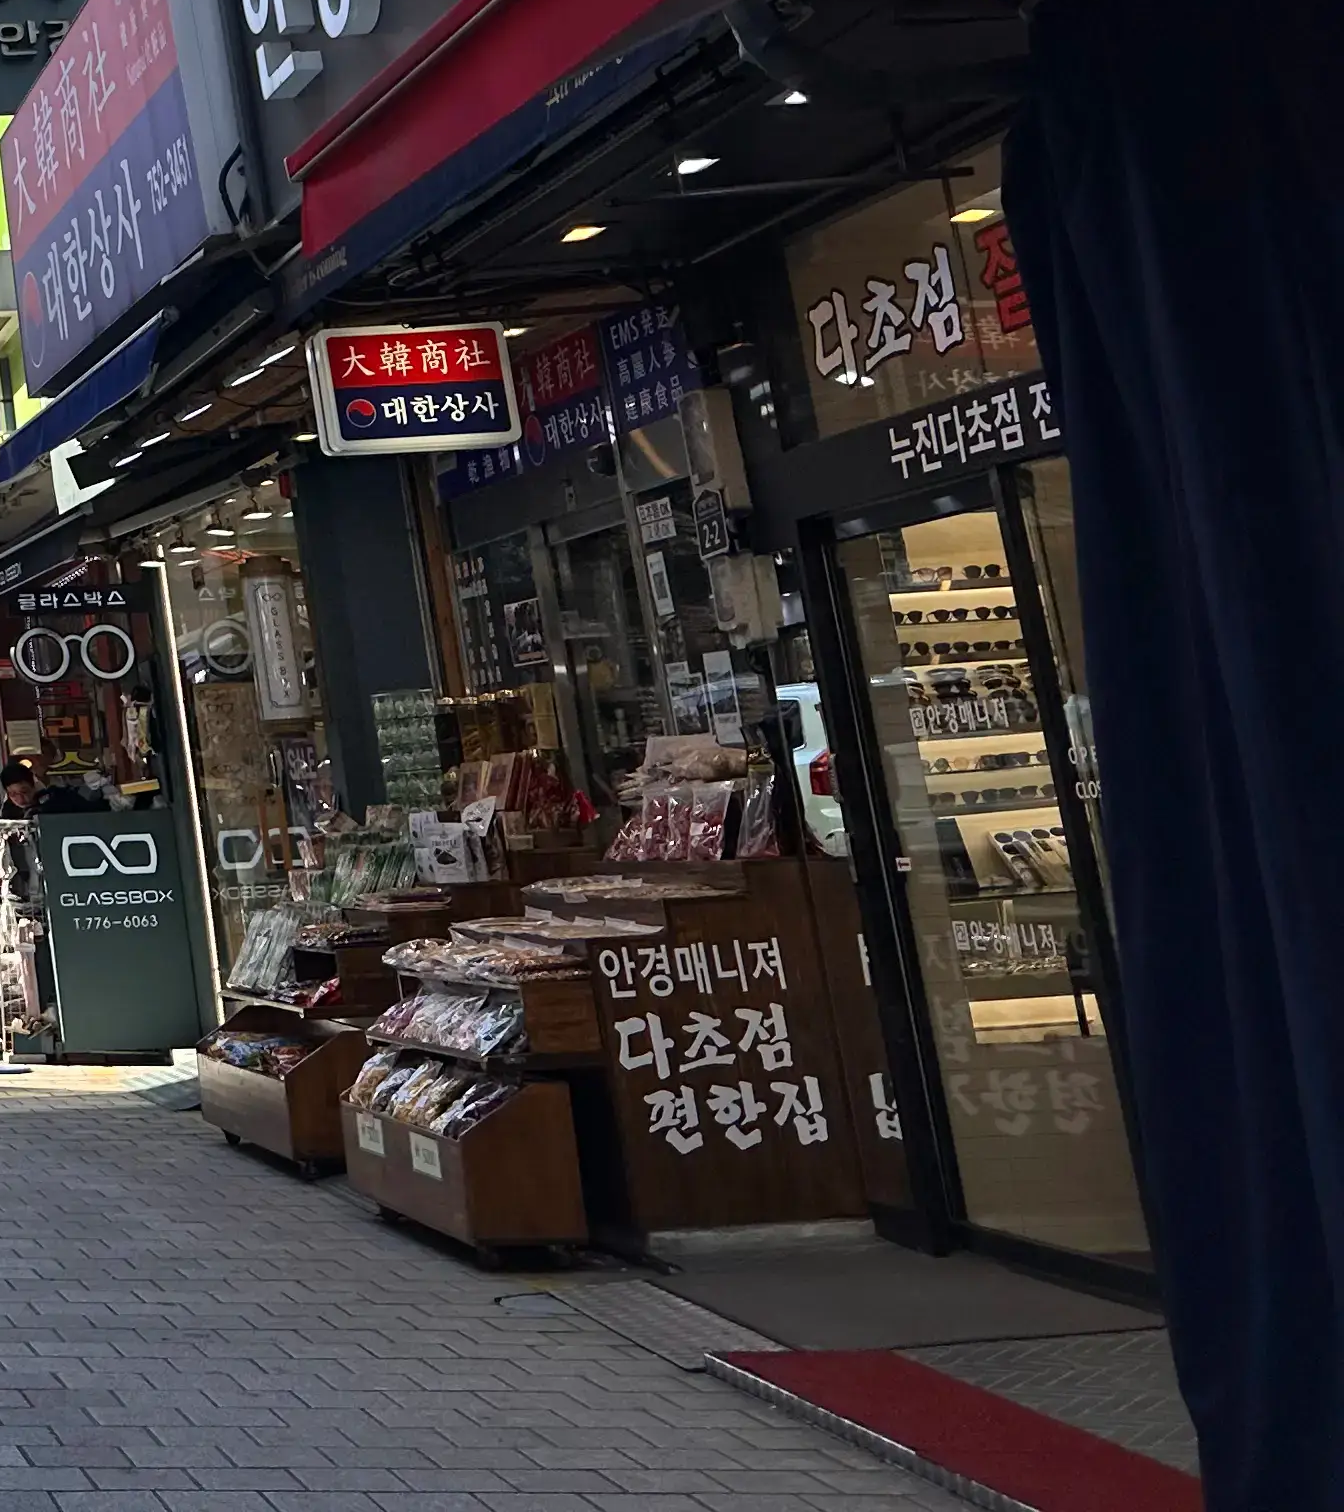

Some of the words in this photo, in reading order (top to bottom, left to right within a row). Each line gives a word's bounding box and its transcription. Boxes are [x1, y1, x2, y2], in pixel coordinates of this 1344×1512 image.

[12, 20, 116, 237] 大韓商社
[145, 133, 192, 217] 752-3451
[40, 158, 145, 342] 대한상사
[808, 244, 964, 378] 다초점
[341, 338, 492, 379] 大韓商社
[381, 392, 499, 426] 대한상사
[544, 395, 608, 450] 대한상사
[888, 387, 1025, 480] 누진다초점
[17, 590, 127, 610] 글라스박스
[924, 697, 1009, 735] 안경매니져
[60, 891, 175, 906] GLASSBOX
[73, 914, 159, 930] T.776-6063
[598, 936, 788, 999] 안경매니져
[613, 1002, 794, 1080] 다초점
[643, 1074, 829, 1155] 편한집
